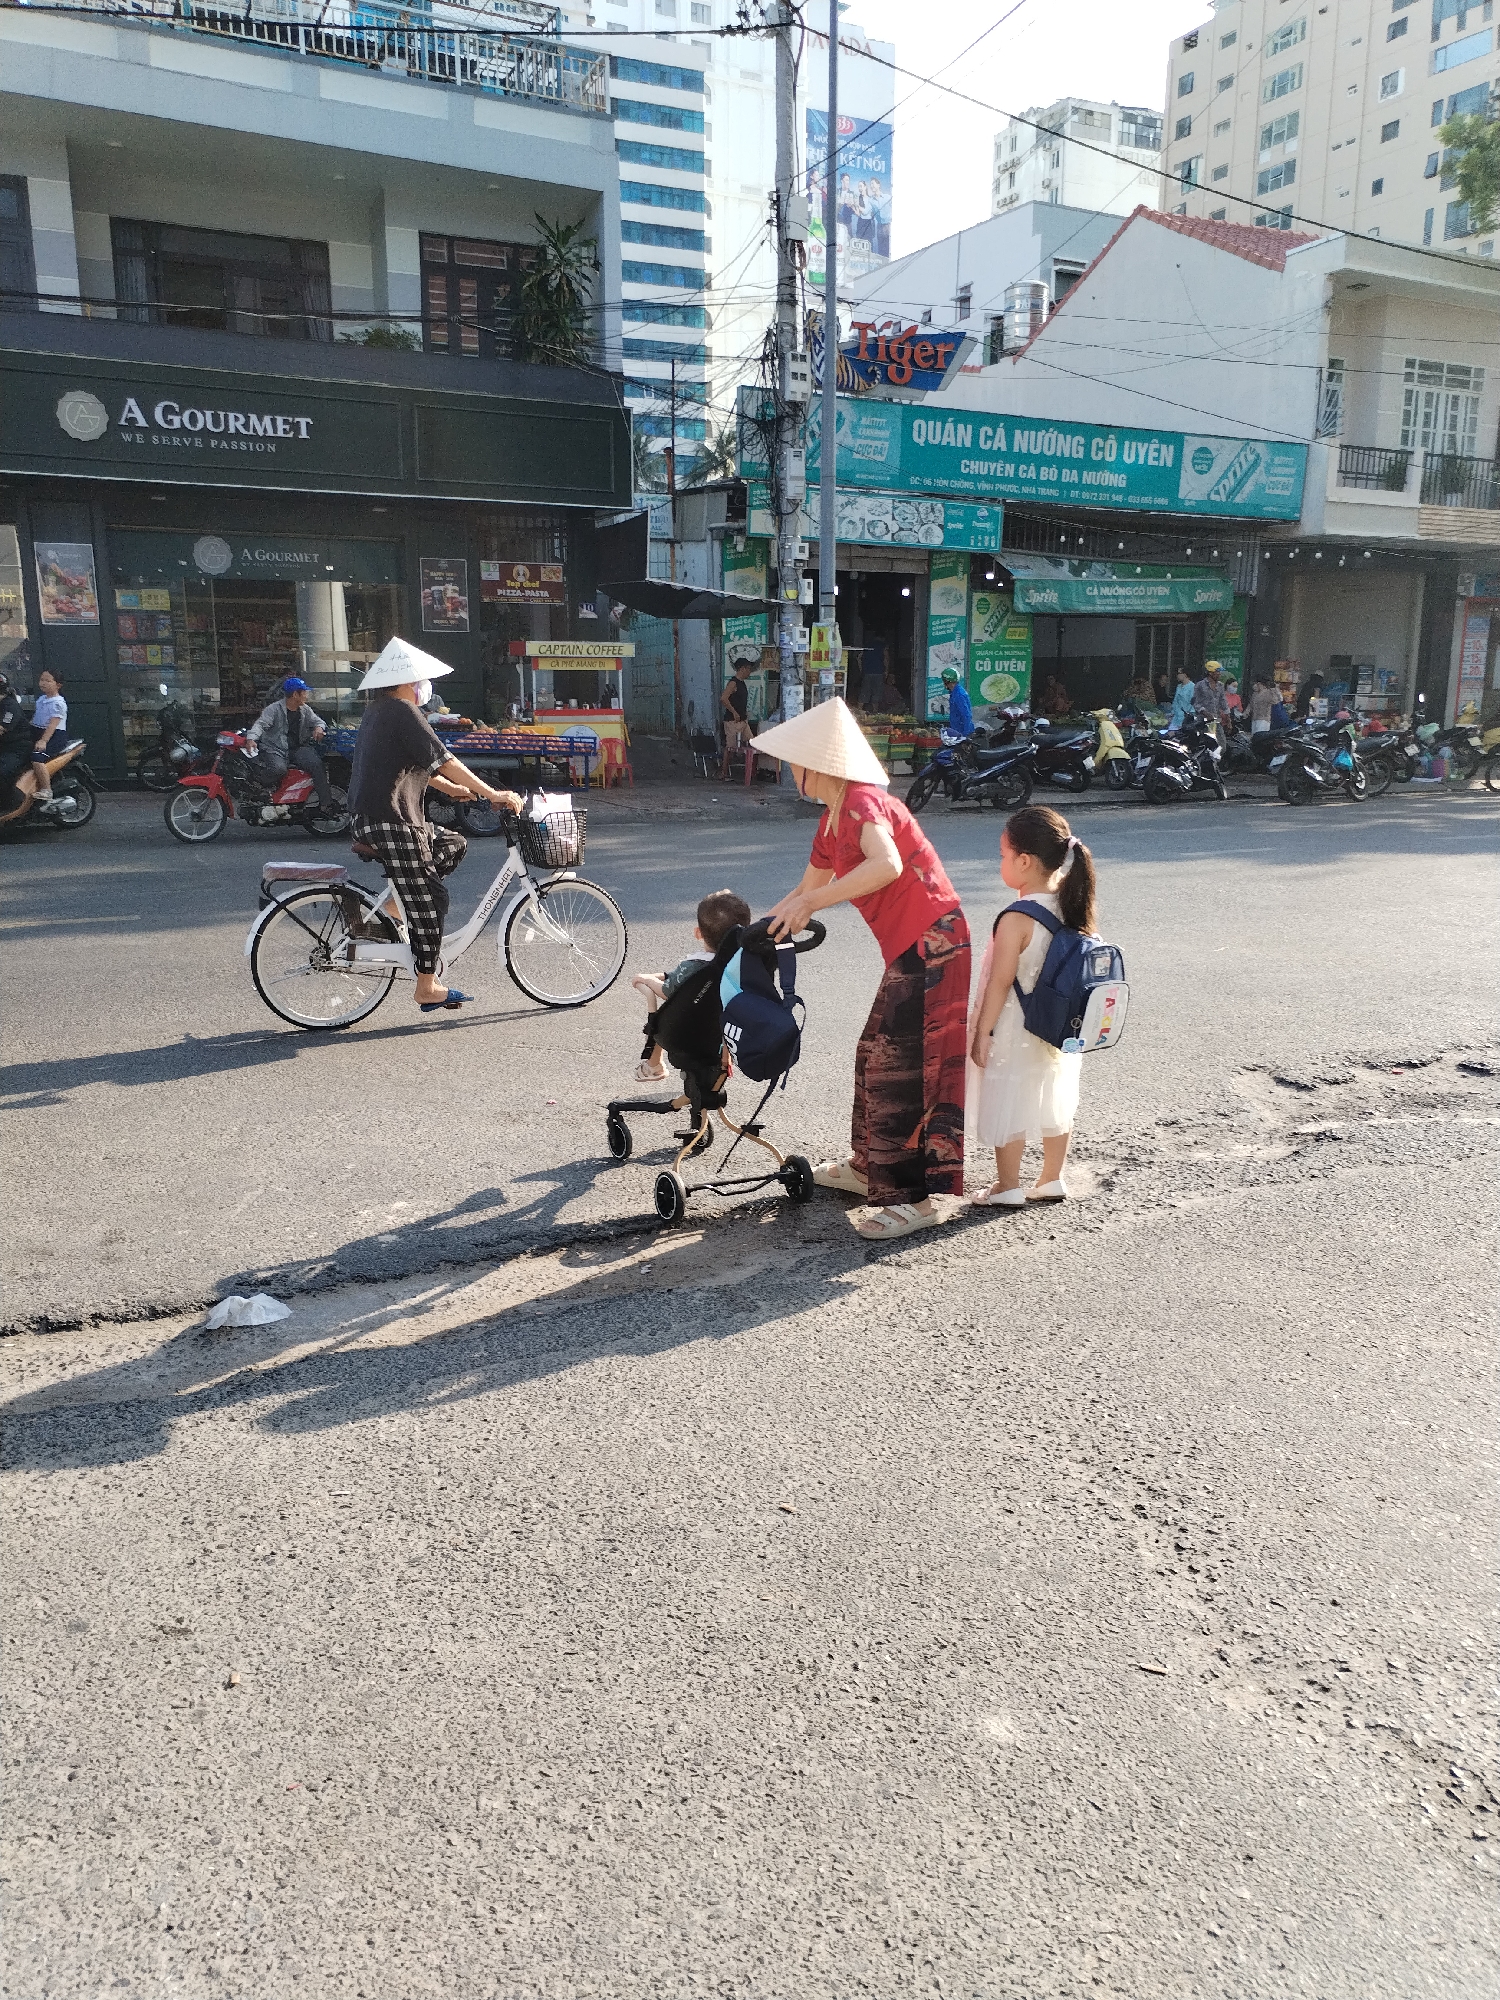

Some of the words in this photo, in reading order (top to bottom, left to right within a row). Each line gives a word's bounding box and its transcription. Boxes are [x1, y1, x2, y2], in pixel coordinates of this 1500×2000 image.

[850, 320, 955, 384] Tiger
[118, 398, 148, 427] A
[154, 401, 313, 439] GOURMET
[121, 432, 145, 444] WE
[152, 435, 203, 448] SERVE
[210, 439, 276, 453] PASSION
[912, 418, 972, 448] QUÁN
[979, 423, 1007, 452] CÁ
[1013, 427, 1085, 459] NƯỚNG
[1091, 434, 1118, 462] CÔ
[1122, 438, 1175, 467] UYÊN
[960, 459, 1015, 477] CHUYÊN
[1061, 468, 1079, 484] DA
[1021, 485, 1036, 495] NHA
[1037, 487, 1060, 497] TRANG
[241, 548, 253, 561] A
[255, 549, 320, 564] GOURMET
[1025, 588, 1059, 605] Sprite
[1193, 589, 1223, 604] Sprite
[538, 644, 583, 655] CAPTAIN
[586, 645, 624, 656] COFFEE
[975, 658, 992, 672] CÔ
[995, 658, 1027, 672] UYÊN
